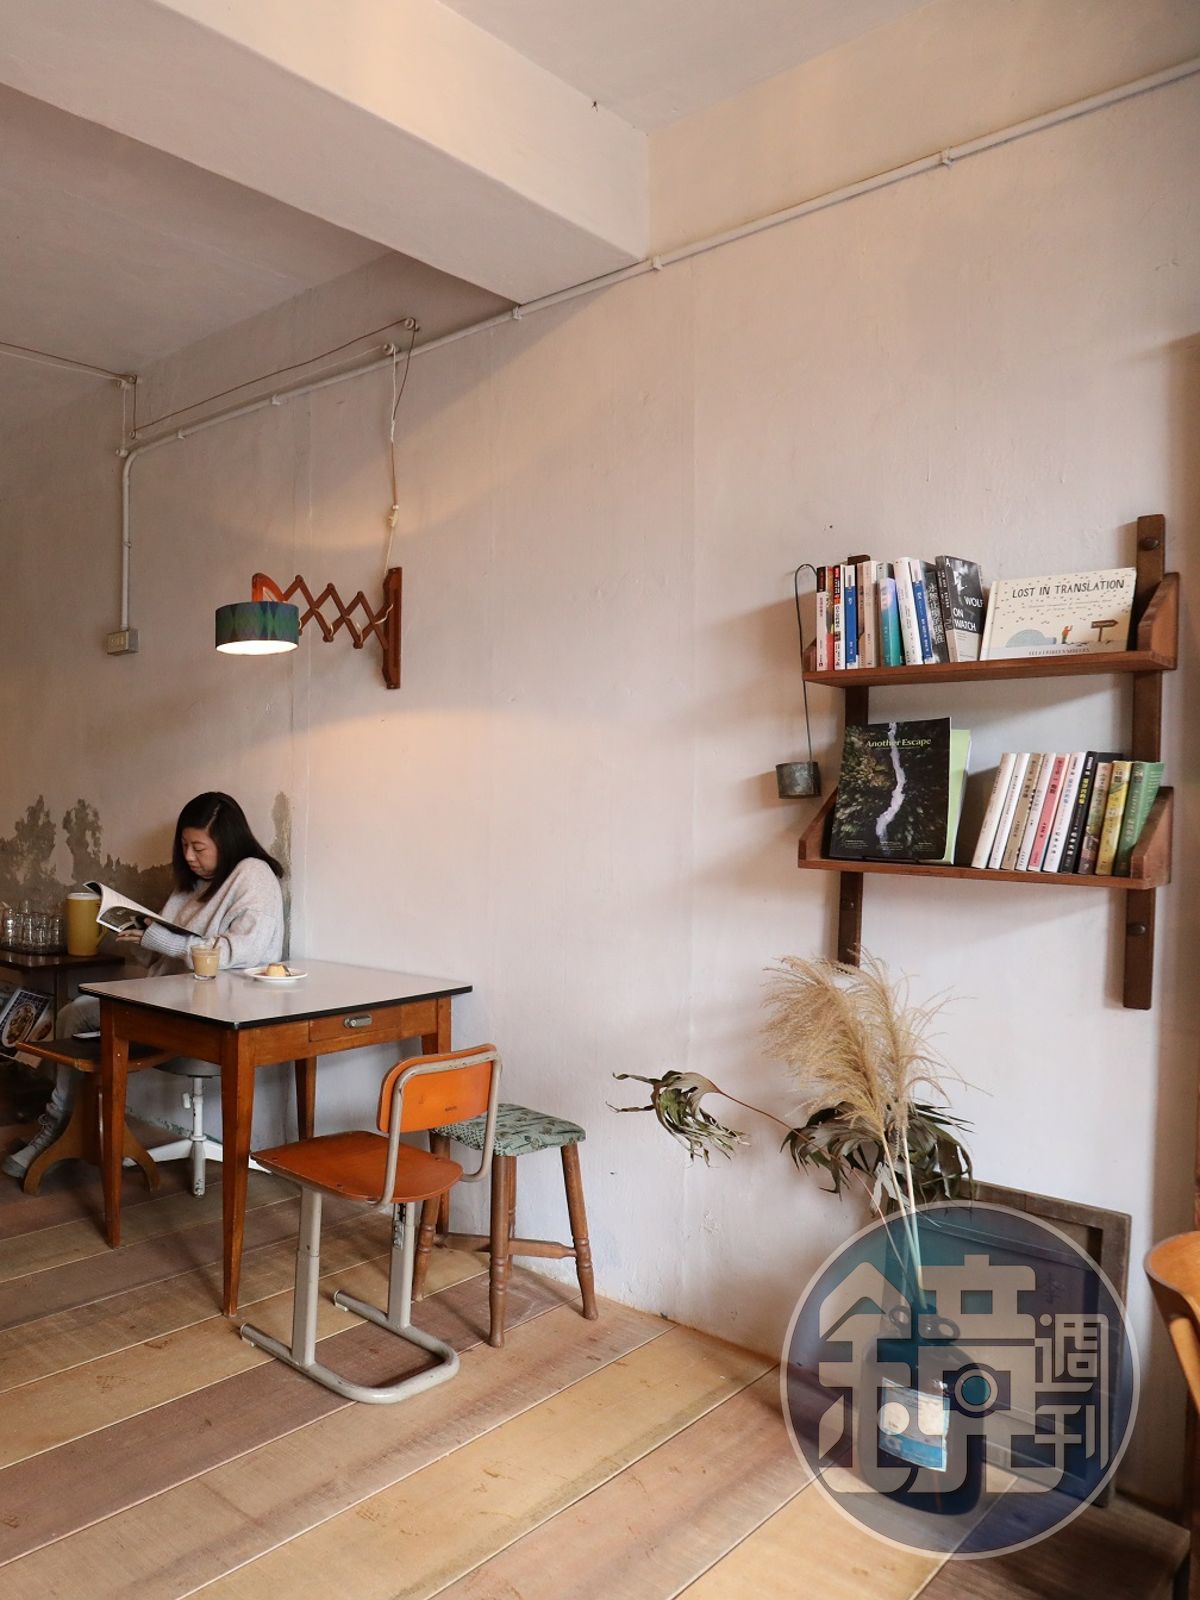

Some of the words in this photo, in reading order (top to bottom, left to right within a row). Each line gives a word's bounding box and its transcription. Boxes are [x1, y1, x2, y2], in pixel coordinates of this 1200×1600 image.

[1012, 587, 1036, 599] LOST
[1039, 585, 1051, 596] IN
[1055, 579, 1125, 594] TRANSLATION
[963, 595, 984, 607] WOLF
[953, 607, 964, 618] ON
[954, 619, 977, 632] WATCH
[866, 738, 901, 748] Another
[902, 737, 932, 749] Escape
